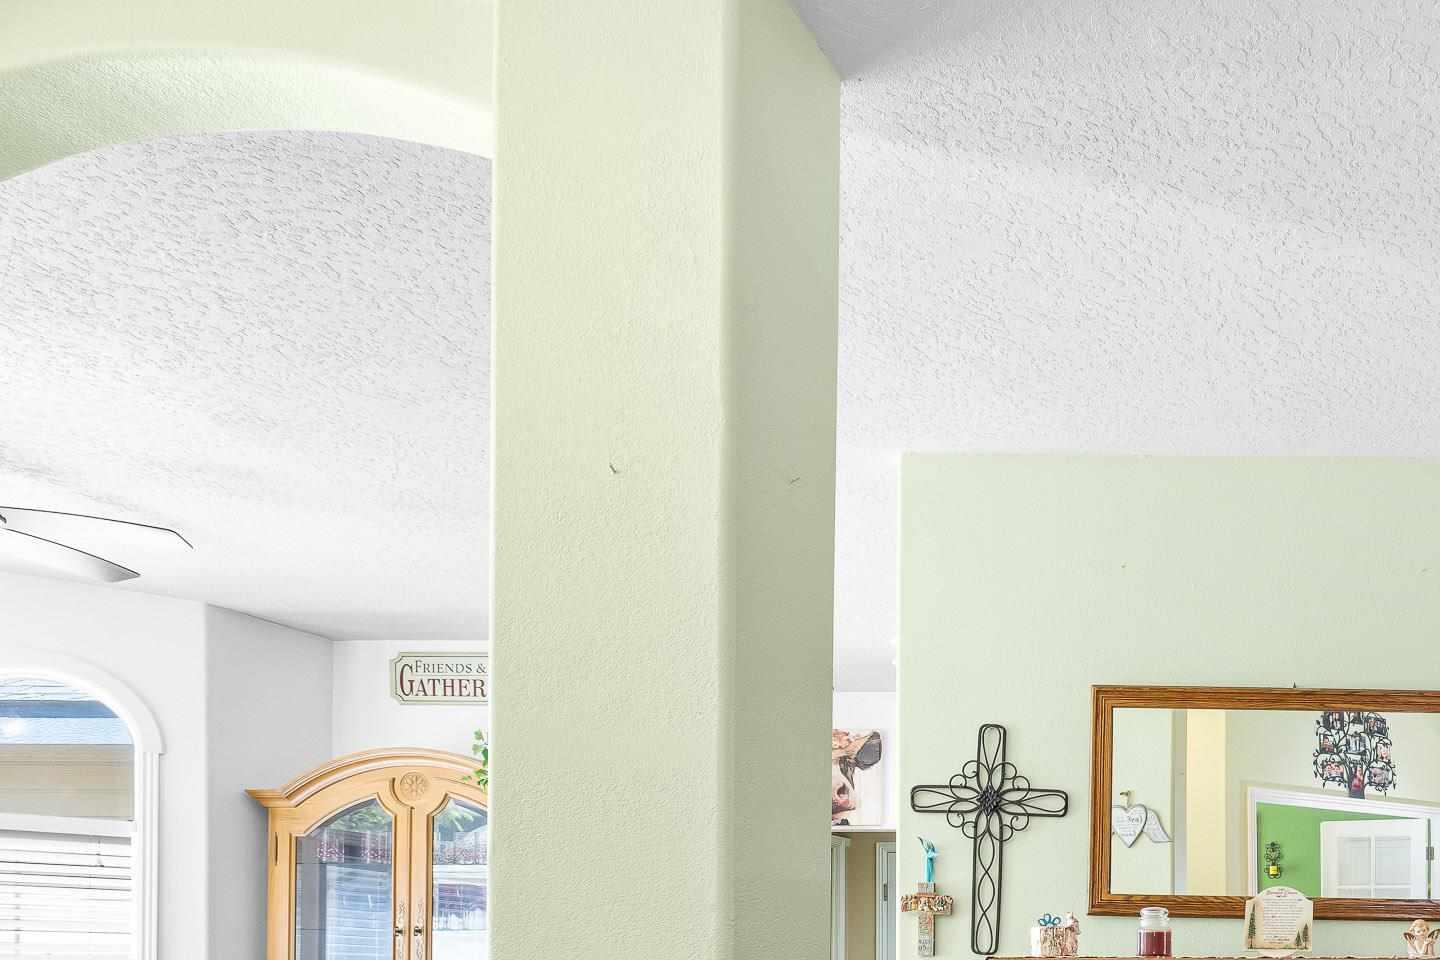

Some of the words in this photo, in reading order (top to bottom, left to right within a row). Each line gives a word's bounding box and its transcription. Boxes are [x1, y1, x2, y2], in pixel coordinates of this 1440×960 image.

[415, 660, 473, 673] FRIENDS
[476, 663, 488, 674] &
[400, 663, 488, 698] GATHER
